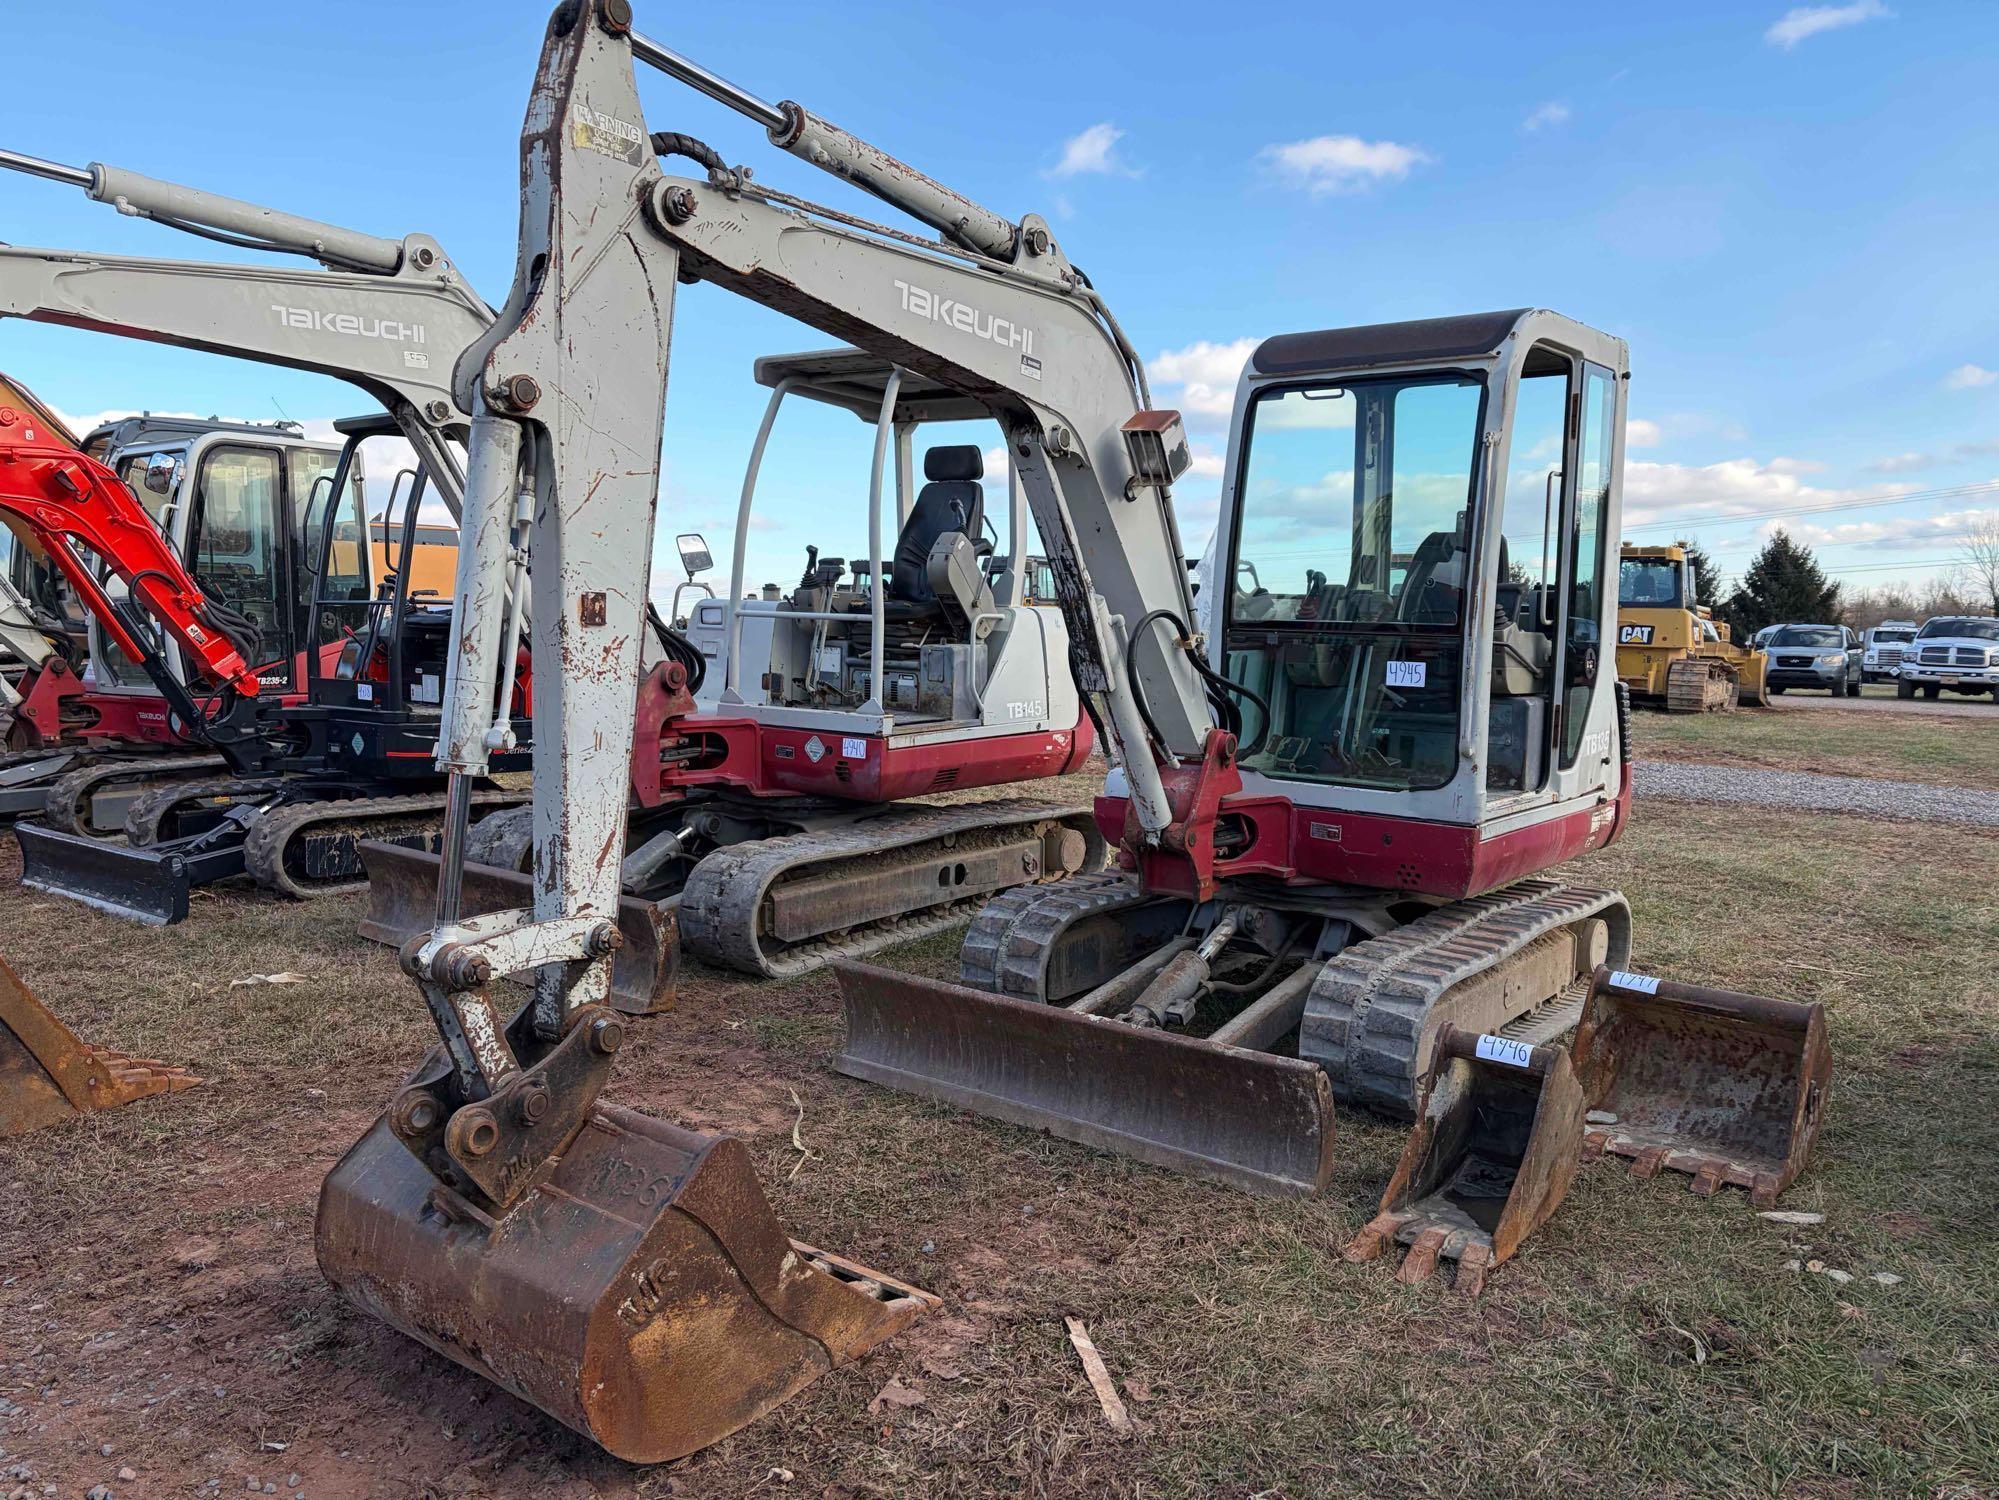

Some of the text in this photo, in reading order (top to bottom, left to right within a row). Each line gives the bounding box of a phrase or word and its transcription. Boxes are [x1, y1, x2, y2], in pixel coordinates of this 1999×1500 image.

[1621, 626, 1651, 643] CAT
[1389, 661, 1422, 684] 4945
[1007, 700, 1042, 719] TB145
[844, 740, 865, 758] 4940
[1484, 1036, 1528, 1062] 4946
